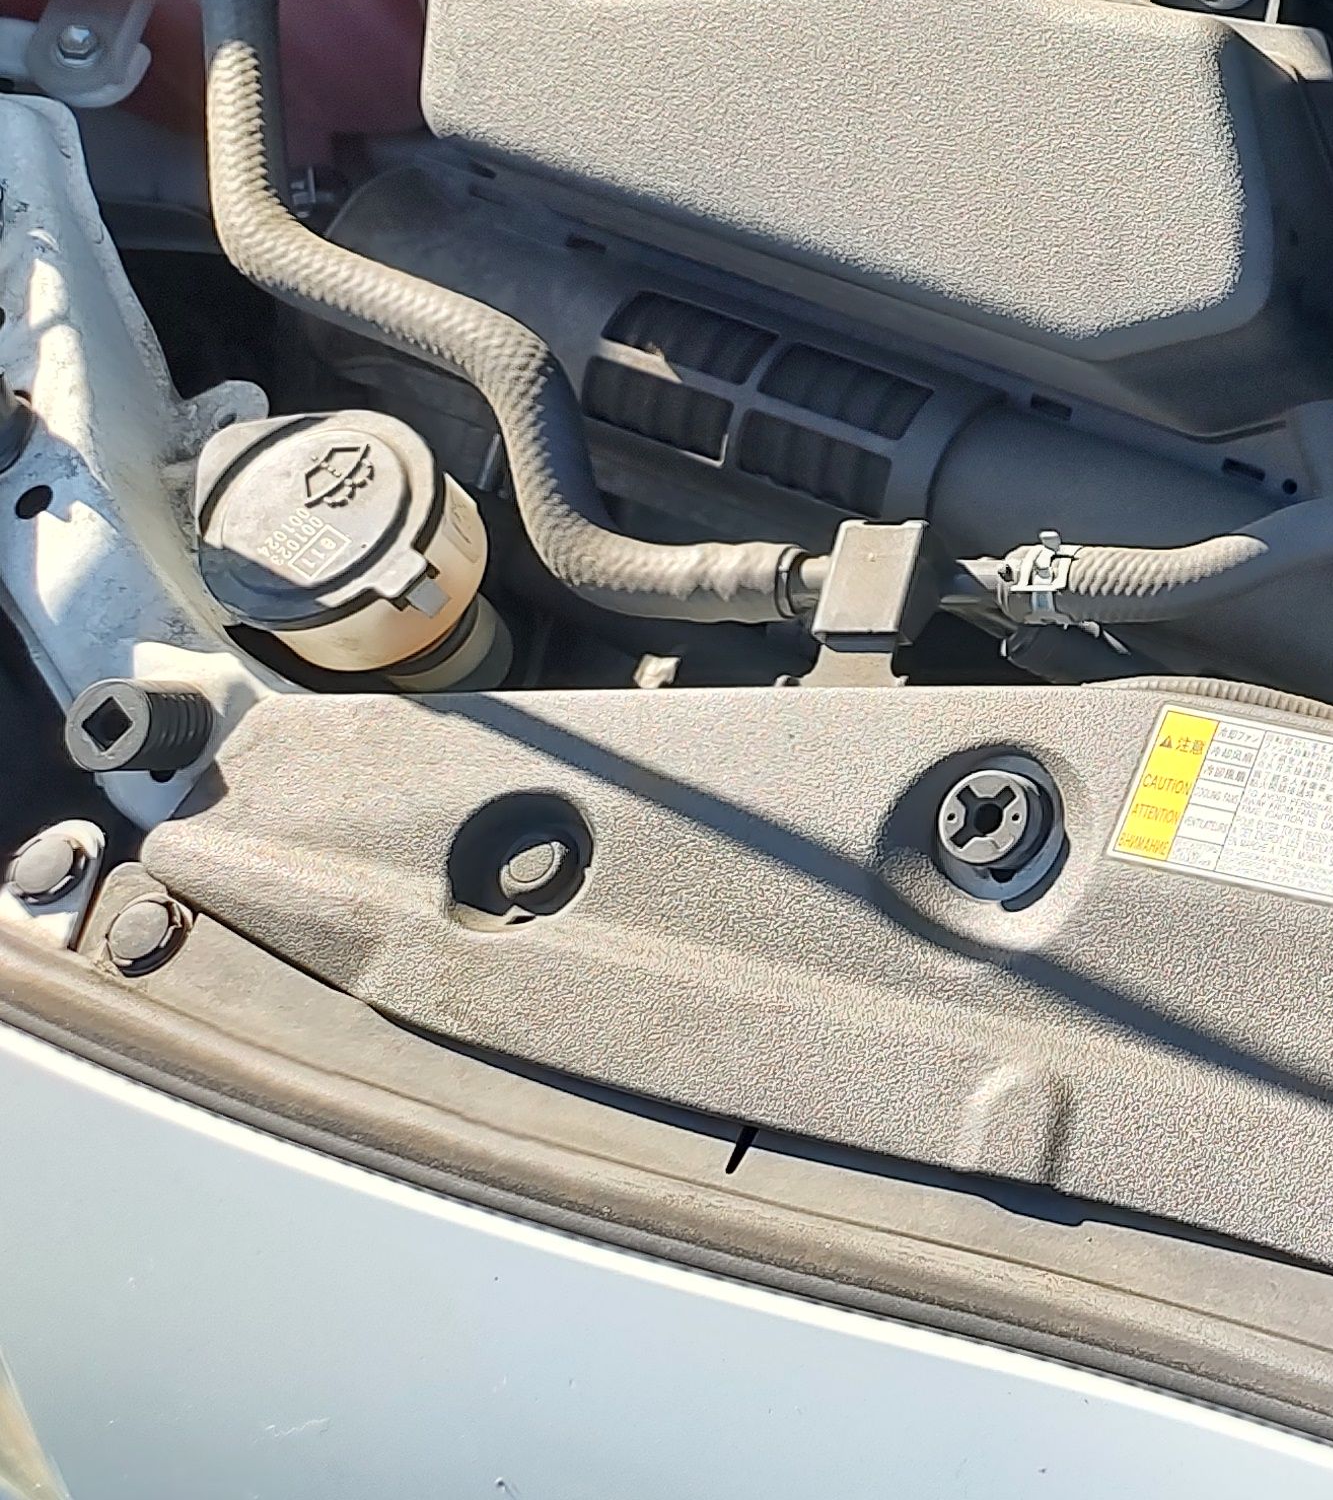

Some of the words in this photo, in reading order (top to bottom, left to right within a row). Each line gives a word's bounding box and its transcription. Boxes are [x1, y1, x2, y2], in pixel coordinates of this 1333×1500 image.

[1174, 735, 1207, 756] 注意
[1141, 772, 1192, 796] CAUTION
[1130, 802, 1181, 825] ATTENTION
